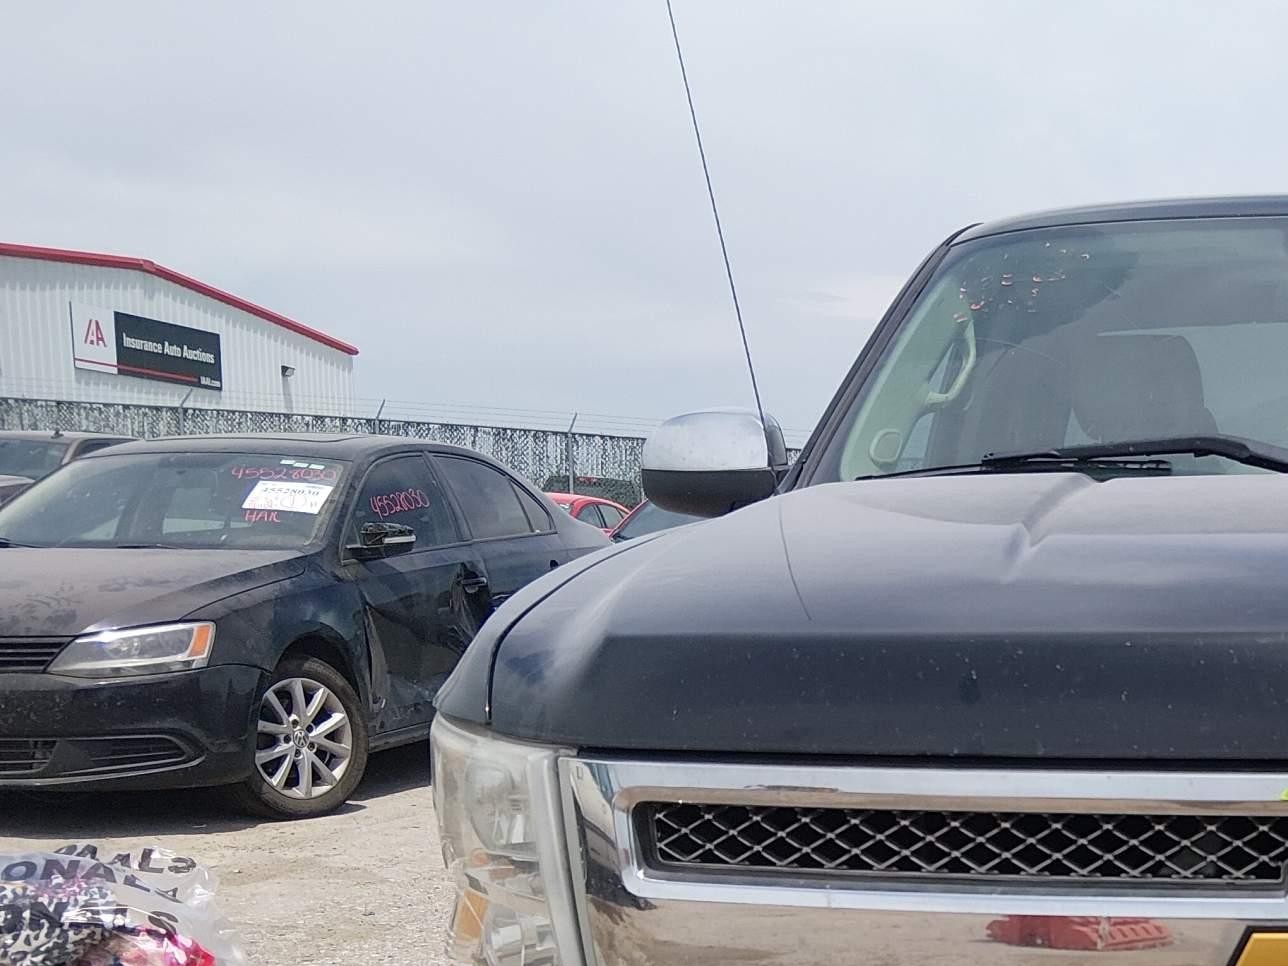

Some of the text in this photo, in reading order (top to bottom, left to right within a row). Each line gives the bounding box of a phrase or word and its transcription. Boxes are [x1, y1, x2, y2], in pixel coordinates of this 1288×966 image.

[122, 332, 216, 364] Insurance Auto Auctions
[231, 467, 337, 481] 45528030
[370, 488, 430, 521] 45528030
